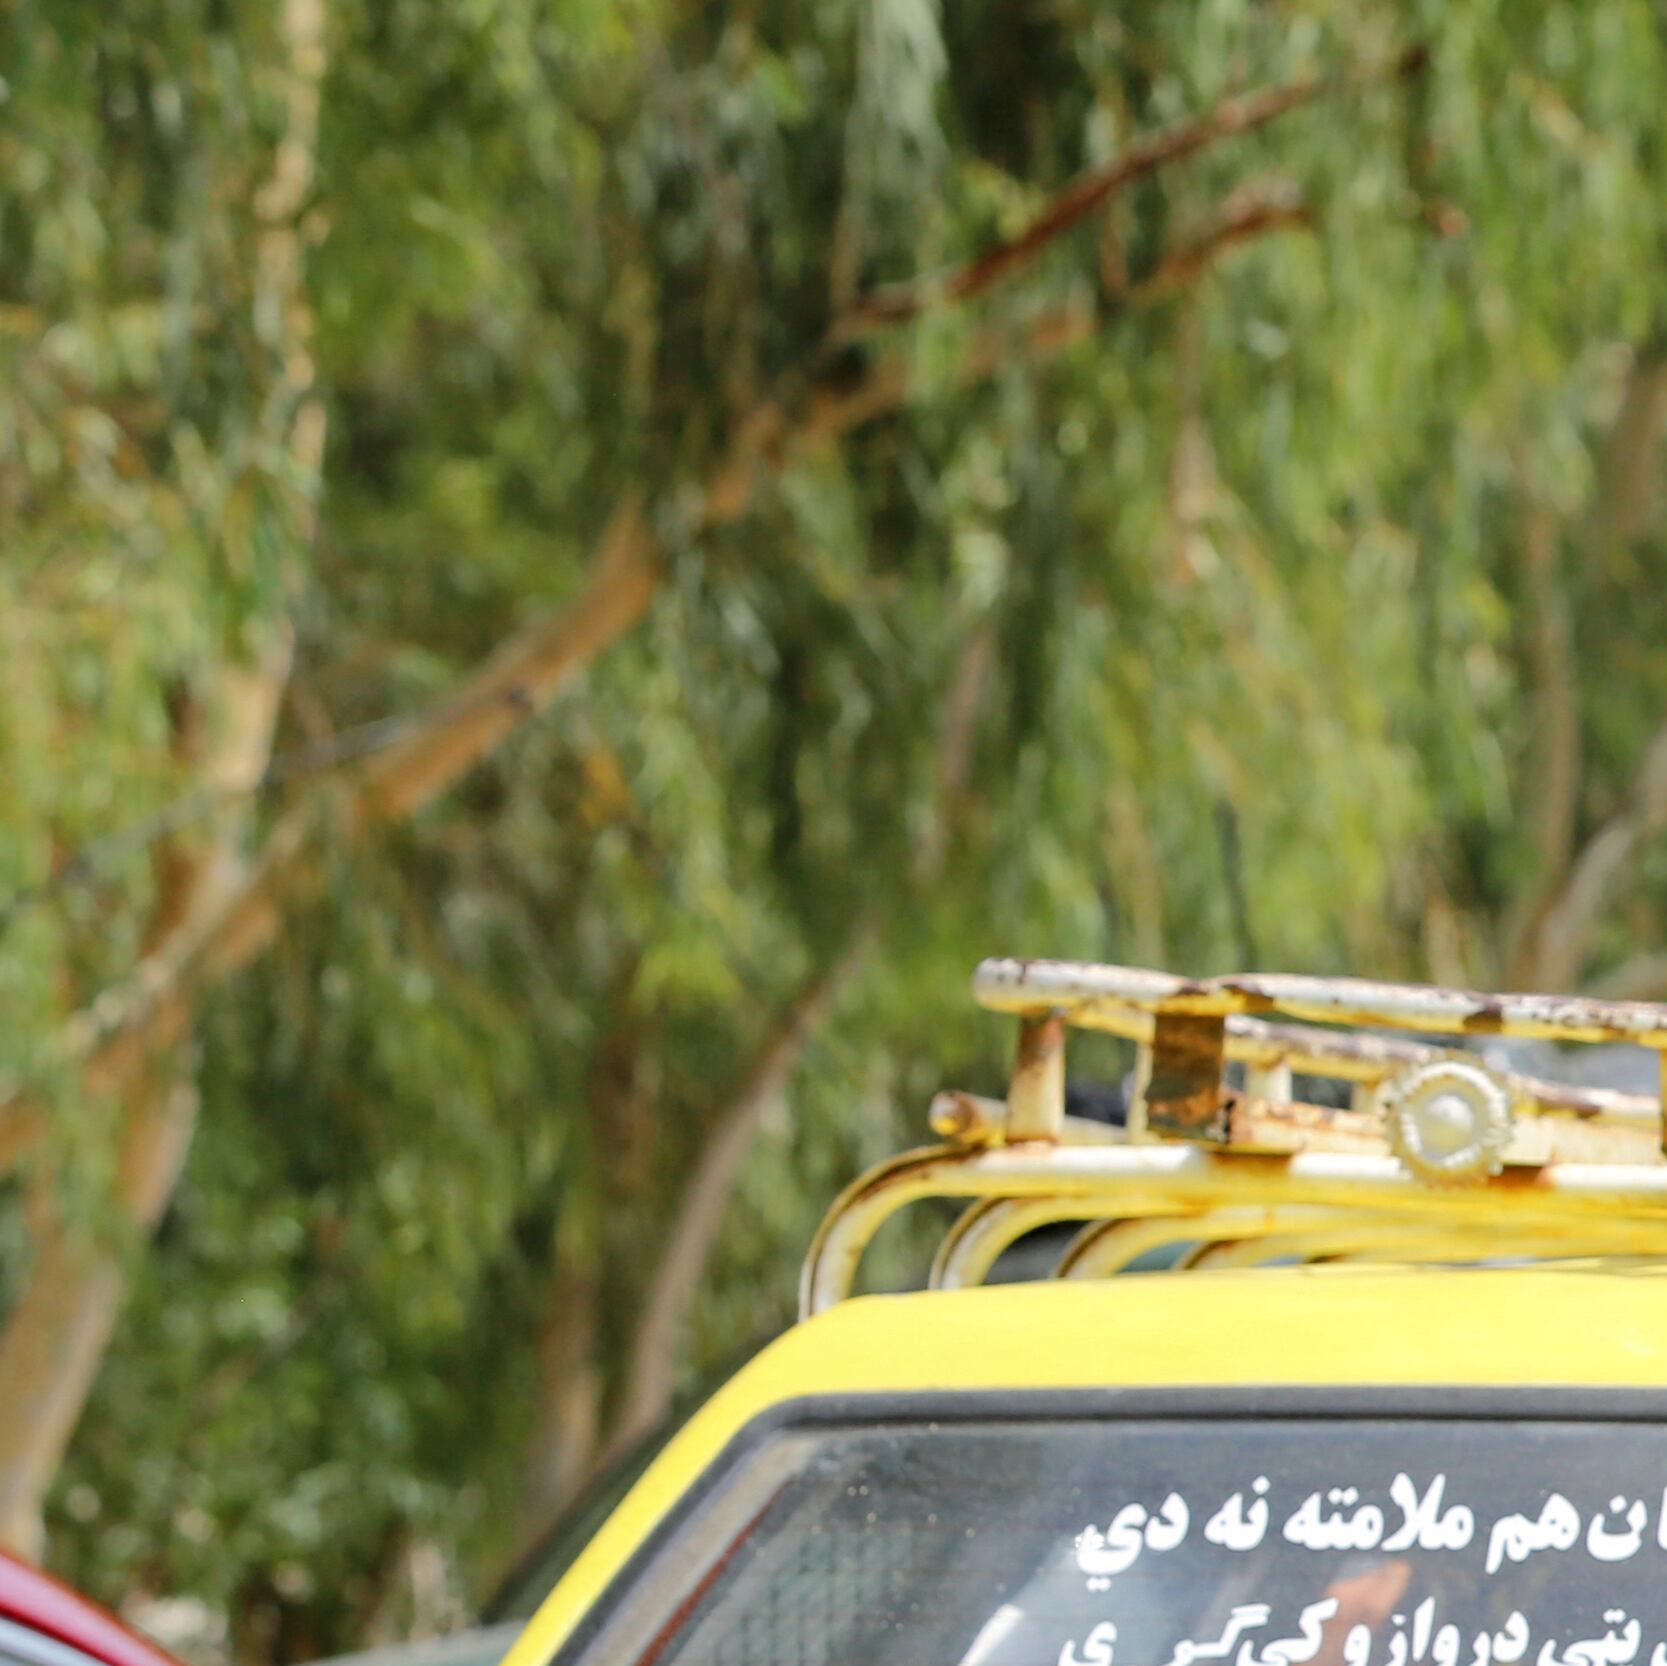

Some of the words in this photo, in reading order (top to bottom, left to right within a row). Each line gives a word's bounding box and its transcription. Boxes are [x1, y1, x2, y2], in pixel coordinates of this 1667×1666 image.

[1204, 1476, 1269, 1550] نه
[1282, 1472, 1474, 1552] ملامته
[1485, 1493, 1581, 1575] هم
